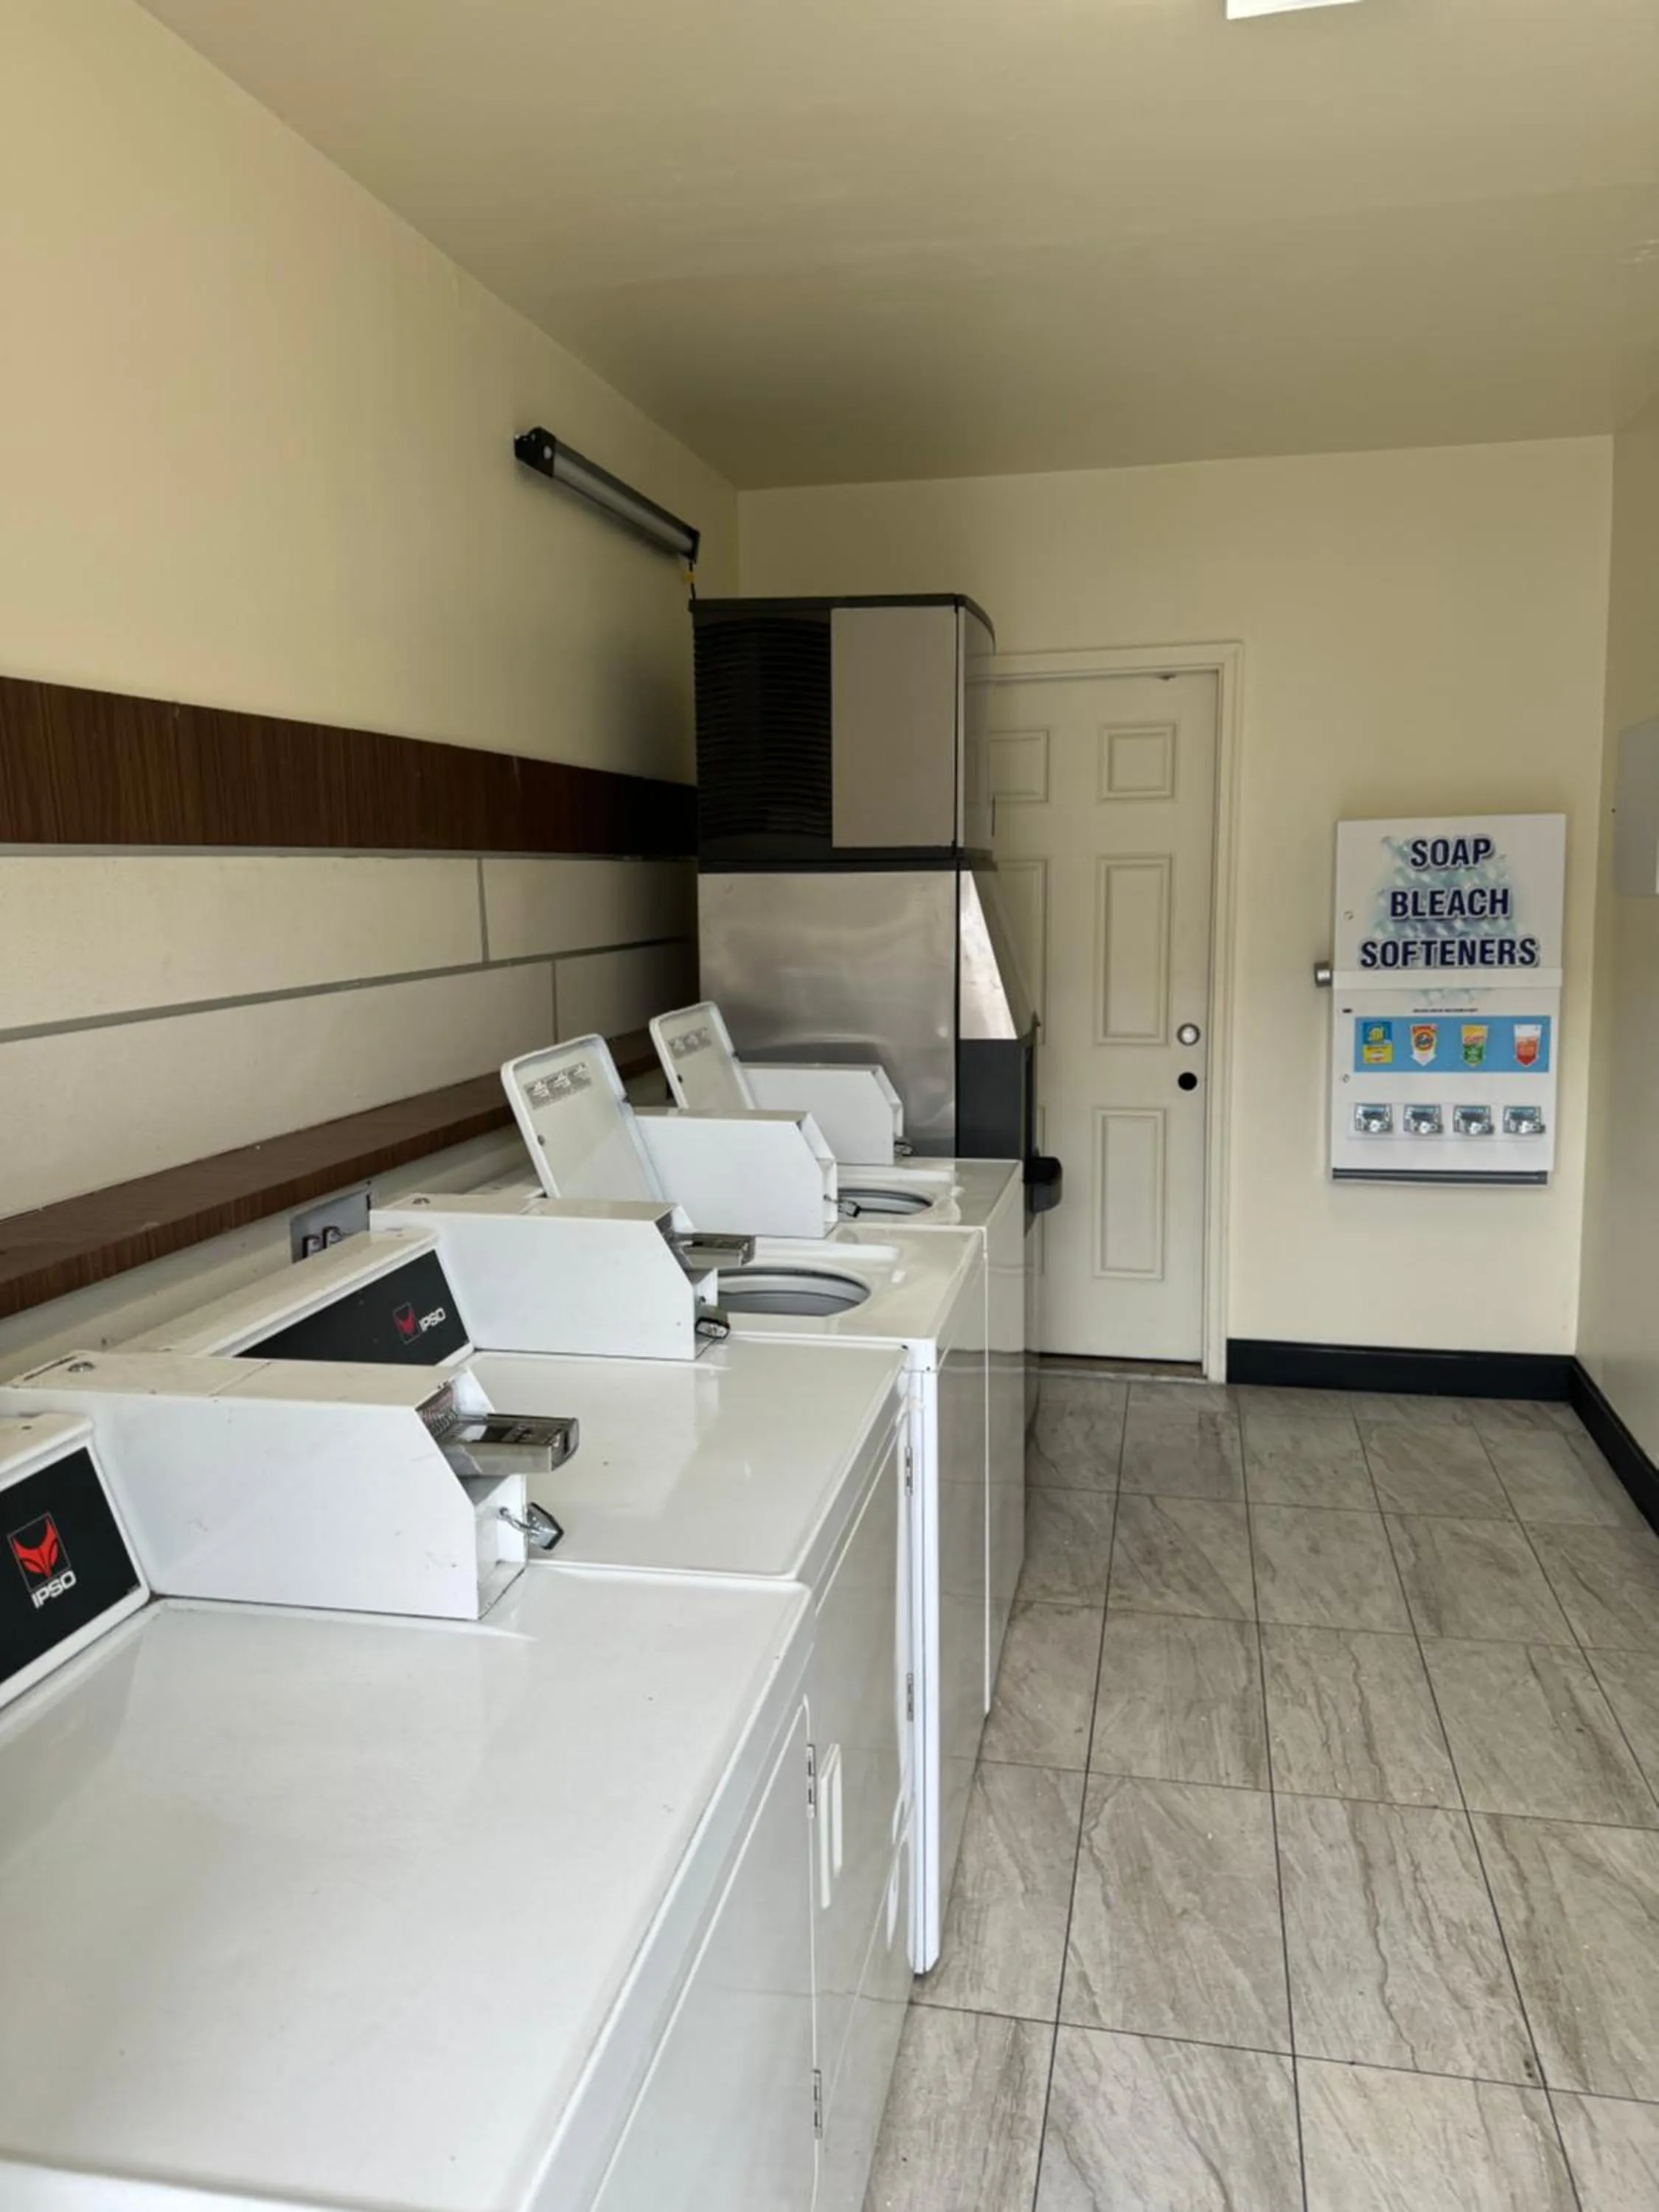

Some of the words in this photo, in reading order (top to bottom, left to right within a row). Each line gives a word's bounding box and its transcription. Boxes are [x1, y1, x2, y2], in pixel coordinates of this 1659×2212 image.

[1410, 838, 1492, 868] SOAP
[1390, 888, 1509, 918] BLEACH
[1360, 938, 1538, 968] SOFTENERS
[419, 1307, 446, 1332] IPSO
[31, 1570, 77, 1609] IPSO
